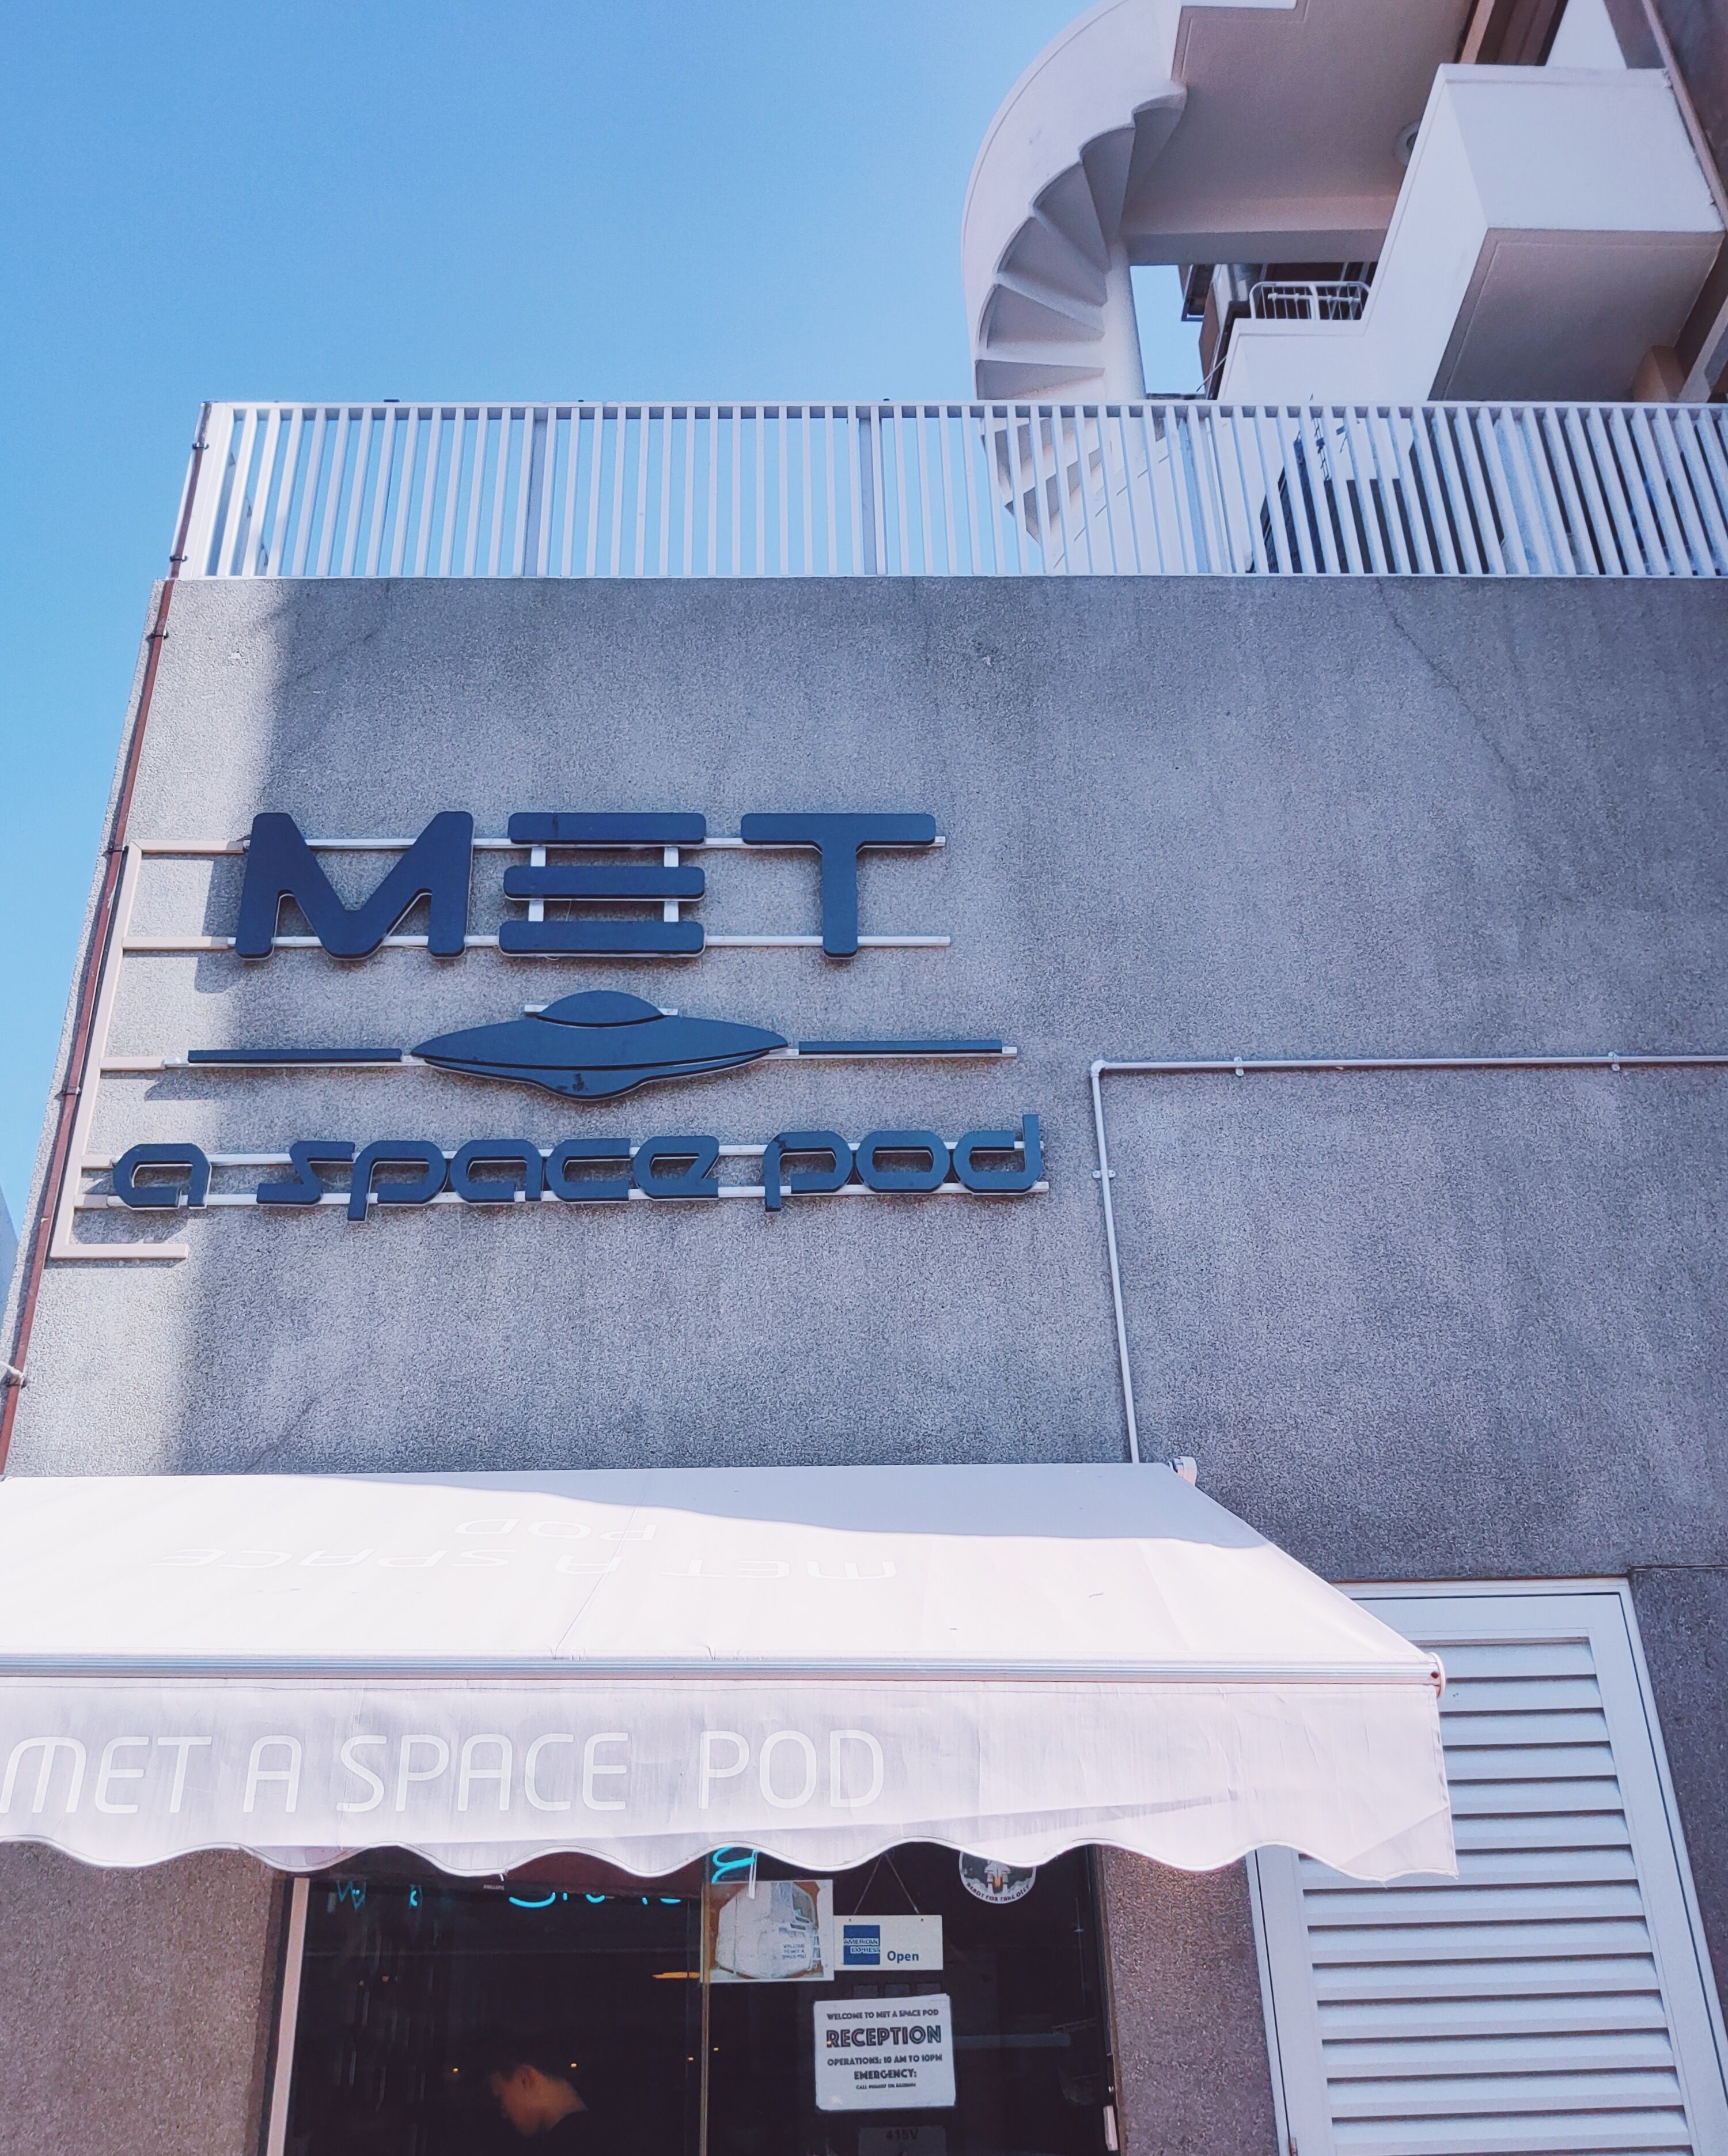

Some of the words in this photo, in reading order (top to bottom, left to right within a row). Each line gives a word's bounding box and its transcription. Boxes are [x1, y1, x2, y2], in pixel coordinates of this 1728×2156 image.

[234, 811, 937, 960] MET
[115, 1143, 211, 1210] a
[256, 1134, 719, 1222] space
[763, 1114, 1043, 1212] pod
[453, 1518, 660, 1542] POD
[148, 1547, 516, 1569] SPACE
[554, 1553, 623, 1575] A
[660, 1557, 898, 1581] MET
[0, 1735, 213, 1814] MET
[242, 1734, 302, 1813] A
[336, 1732, 629, 1813] SPACE
[698, 1729, 884, 1810] POD
[887, 1950, 919, 1964] Open
[827, 2011, 863, 2020] WELCOME
[865, 2011, 874, 2019] TO
[876, 2010, 890, 2018] MET
[899, 2009, 921, 2017] SPACE
[827, 2025, 942, 2048] RECEPTION
[827, 2056, 882, 2066] OPERATIONS:
[884, 2056, 892, 2064] 10
[893, 2055, 907, 2063] AM
[908, 2055, 920, 2063] TO
[922, 2053, 942, 2062] 10PM
[854, 2068, 918, 2080] EMERGENCY:
